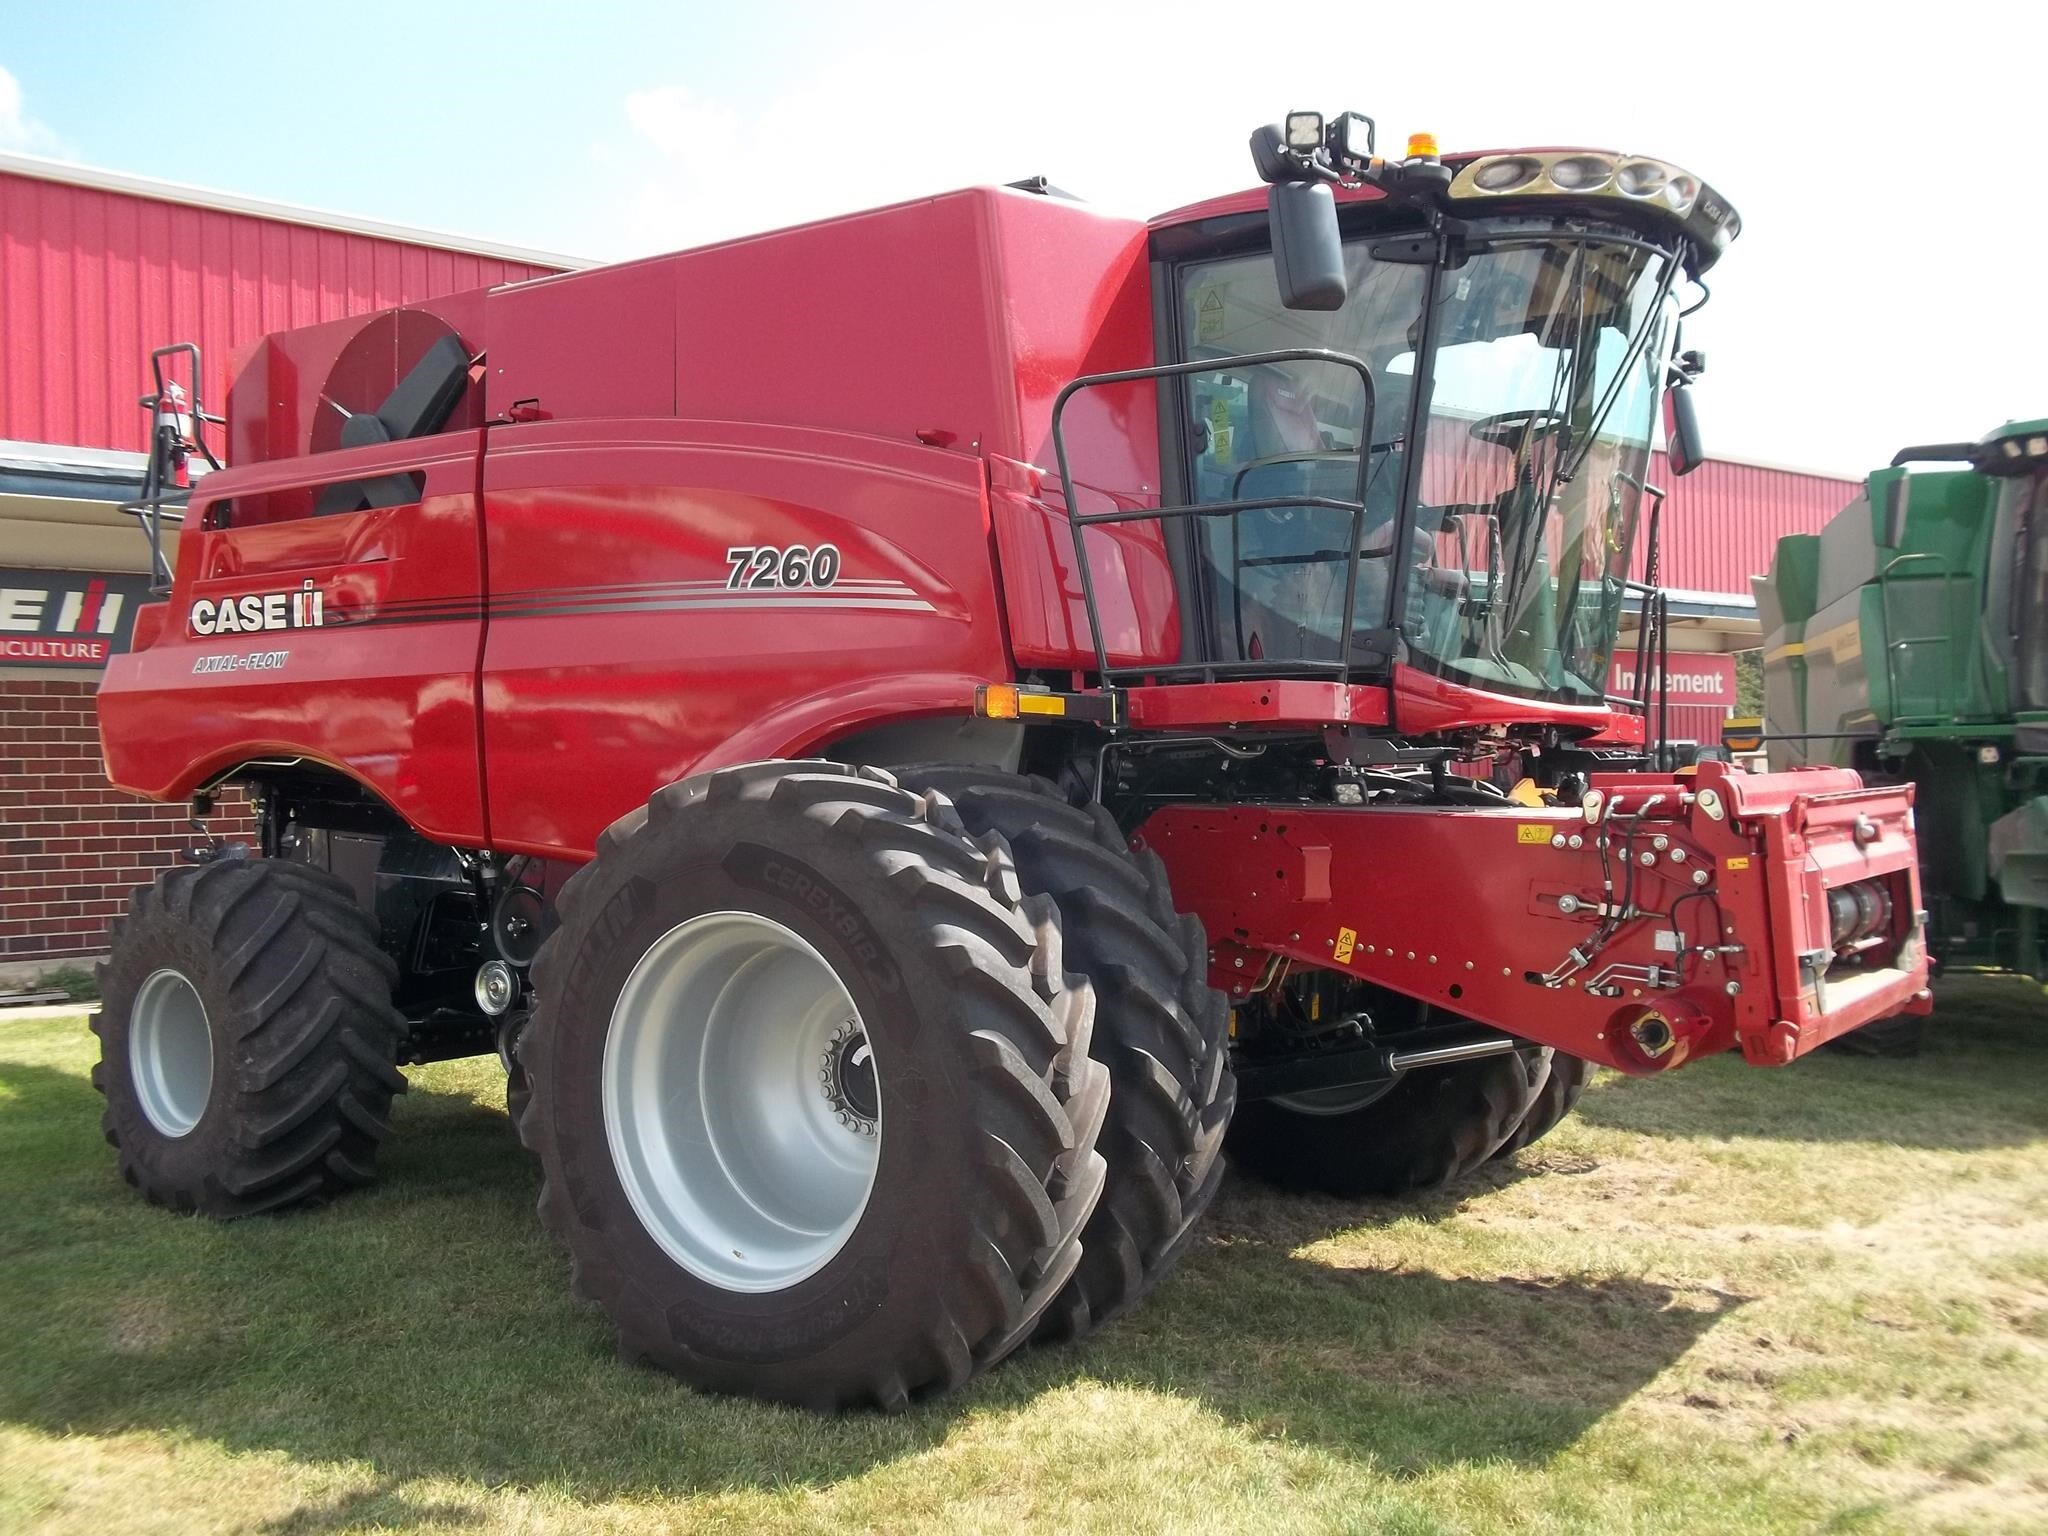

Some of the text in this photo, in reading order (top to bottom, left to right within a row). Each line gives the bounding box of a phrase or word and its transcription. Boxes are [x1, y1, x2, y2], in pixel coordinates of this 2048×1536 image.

[726, 543, 841, 590] 7260
[191, 594, 287, 635] CASE
[192, 650, 289, 674] AXIAL-FLOW
